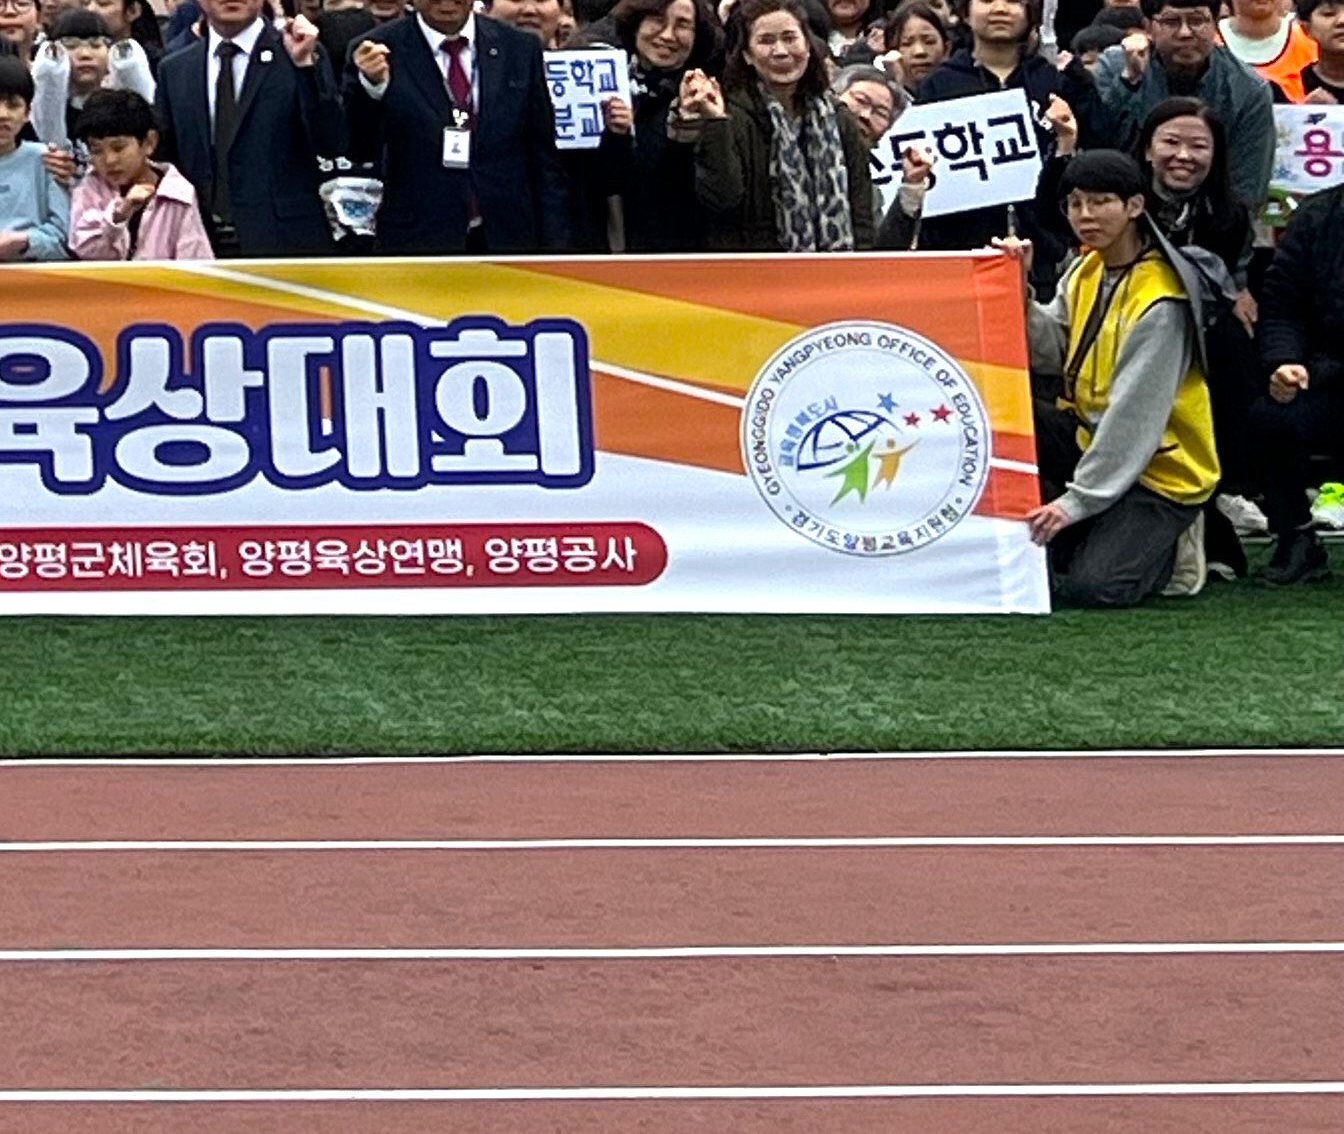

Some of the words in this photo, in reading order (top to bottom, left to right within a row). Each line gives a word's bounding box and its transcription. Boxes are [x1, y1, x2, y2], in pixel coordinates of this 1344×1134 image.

[751, 388, 782, 497] GYEONGGIDO
[769, 331, 873, 385] YANGPYEONG
[877, 333, 938, 371] OFFICE
[935, 368, 958, 391] OF
[950, 391, 980, 488] EDUCATION
[238, 537, 475, 578] 양평육상연맹,
[484, 536, 638, 574] 양평공사
